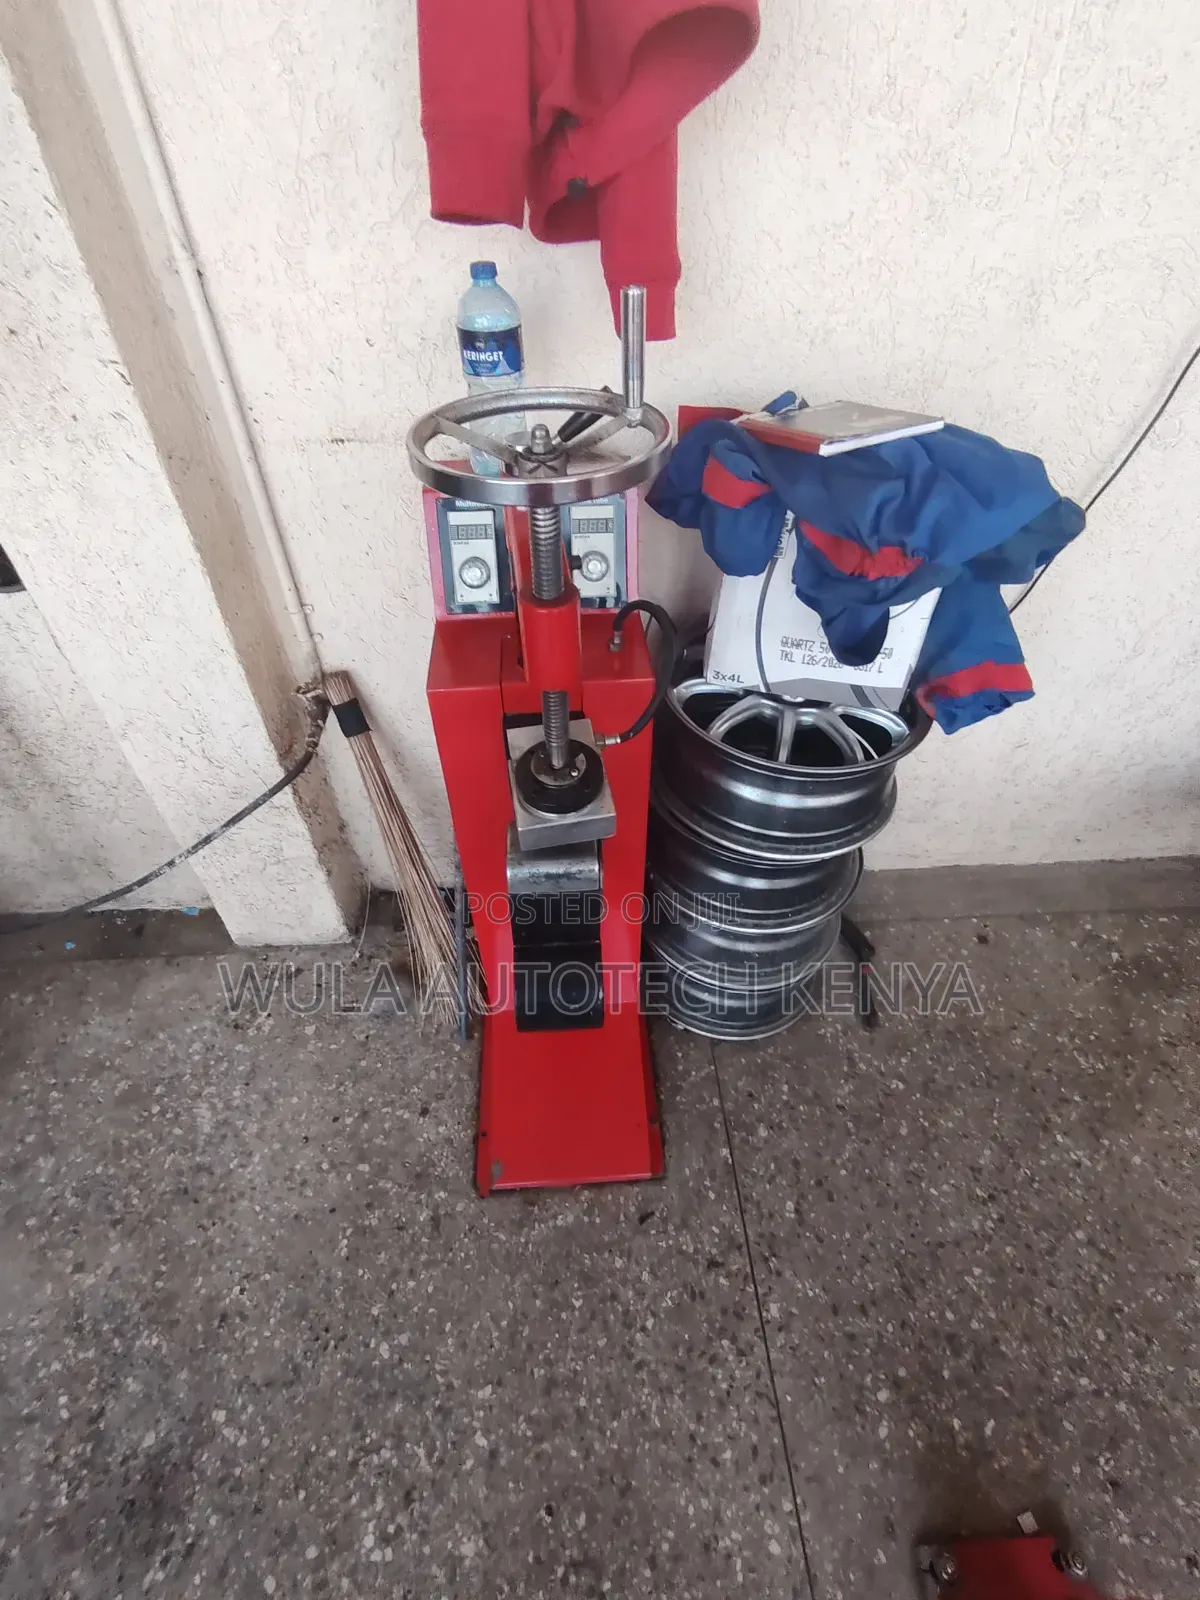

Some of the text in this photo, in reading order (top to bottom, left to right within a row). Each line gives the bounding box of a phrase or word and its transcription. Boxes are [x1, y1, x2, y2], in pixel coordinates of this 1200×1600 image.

[780, 636, 815, 653] QUARTZ
[780, 650, 795, 663] TKL
[712, 669, 745, 684] 3x4L
